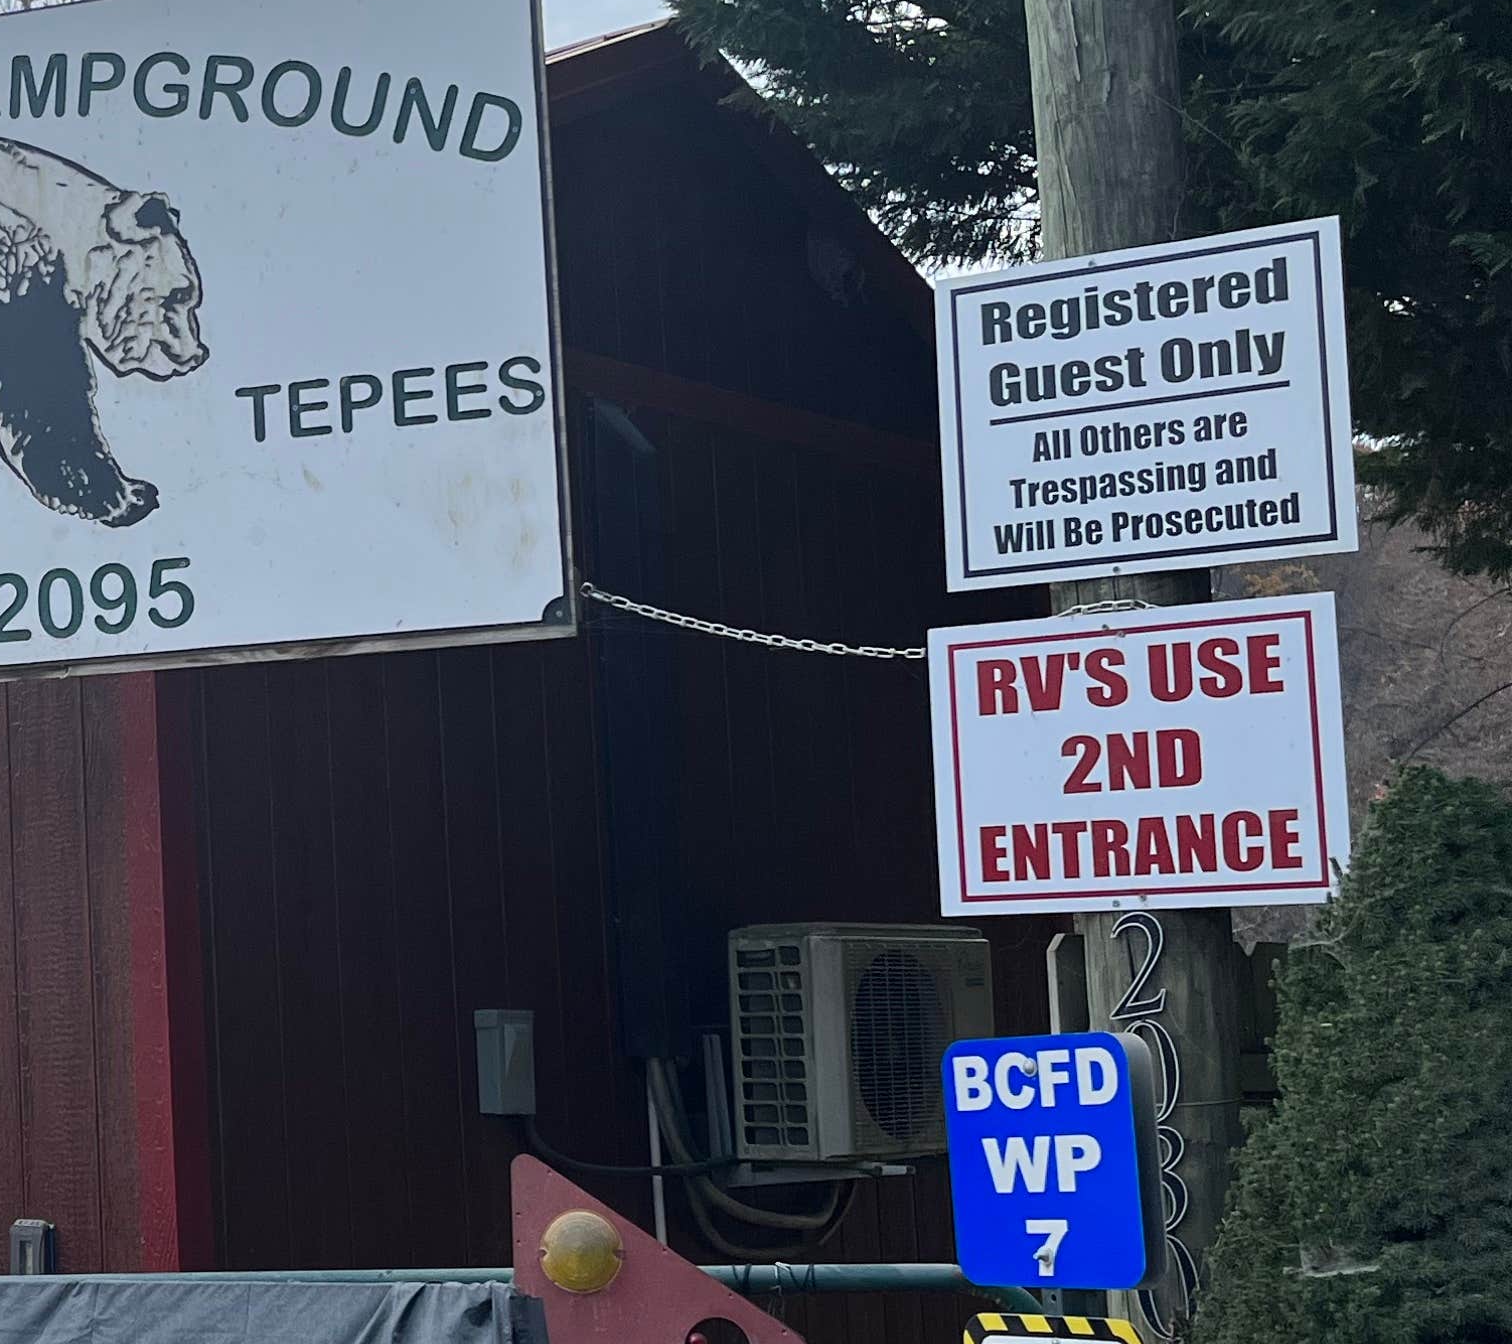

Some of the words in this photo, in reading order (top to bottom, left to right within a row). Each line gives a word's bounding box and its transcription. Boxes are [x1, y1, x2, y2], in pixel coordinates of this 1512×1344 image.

[981, 256, 1289, 346] Registered
[235, 355, 545, 442] TEPEES
[989, 347, 1147, 407] Guest
[1160, 328, 1285, 383] Only
[1032, 428, 1072, 463] All
[1080, 418, 1185, 456] Others
[1193, 410, 1248, 442] are
[1009, 461, 1206, 509] Trespassing
[1215, 448, 1277, 485] and
[993, 519, 1055, 555] Will
[1063, 516, 1103, 548] Be
[1111, 492, 1300, 543] Prosecuted
[976, 647, 1128, 716] RV'S
[1148, 633, 1285, 702] USE
[1061, 728, 1202, 794] 2ND
[980, 809, 1303, 882] ENTRANCE
[952, 1047, 1119, 1112] BCFD
[981, 1134, 1102, 1194] WP
[1025, 1219, 1068, 1277] 7
